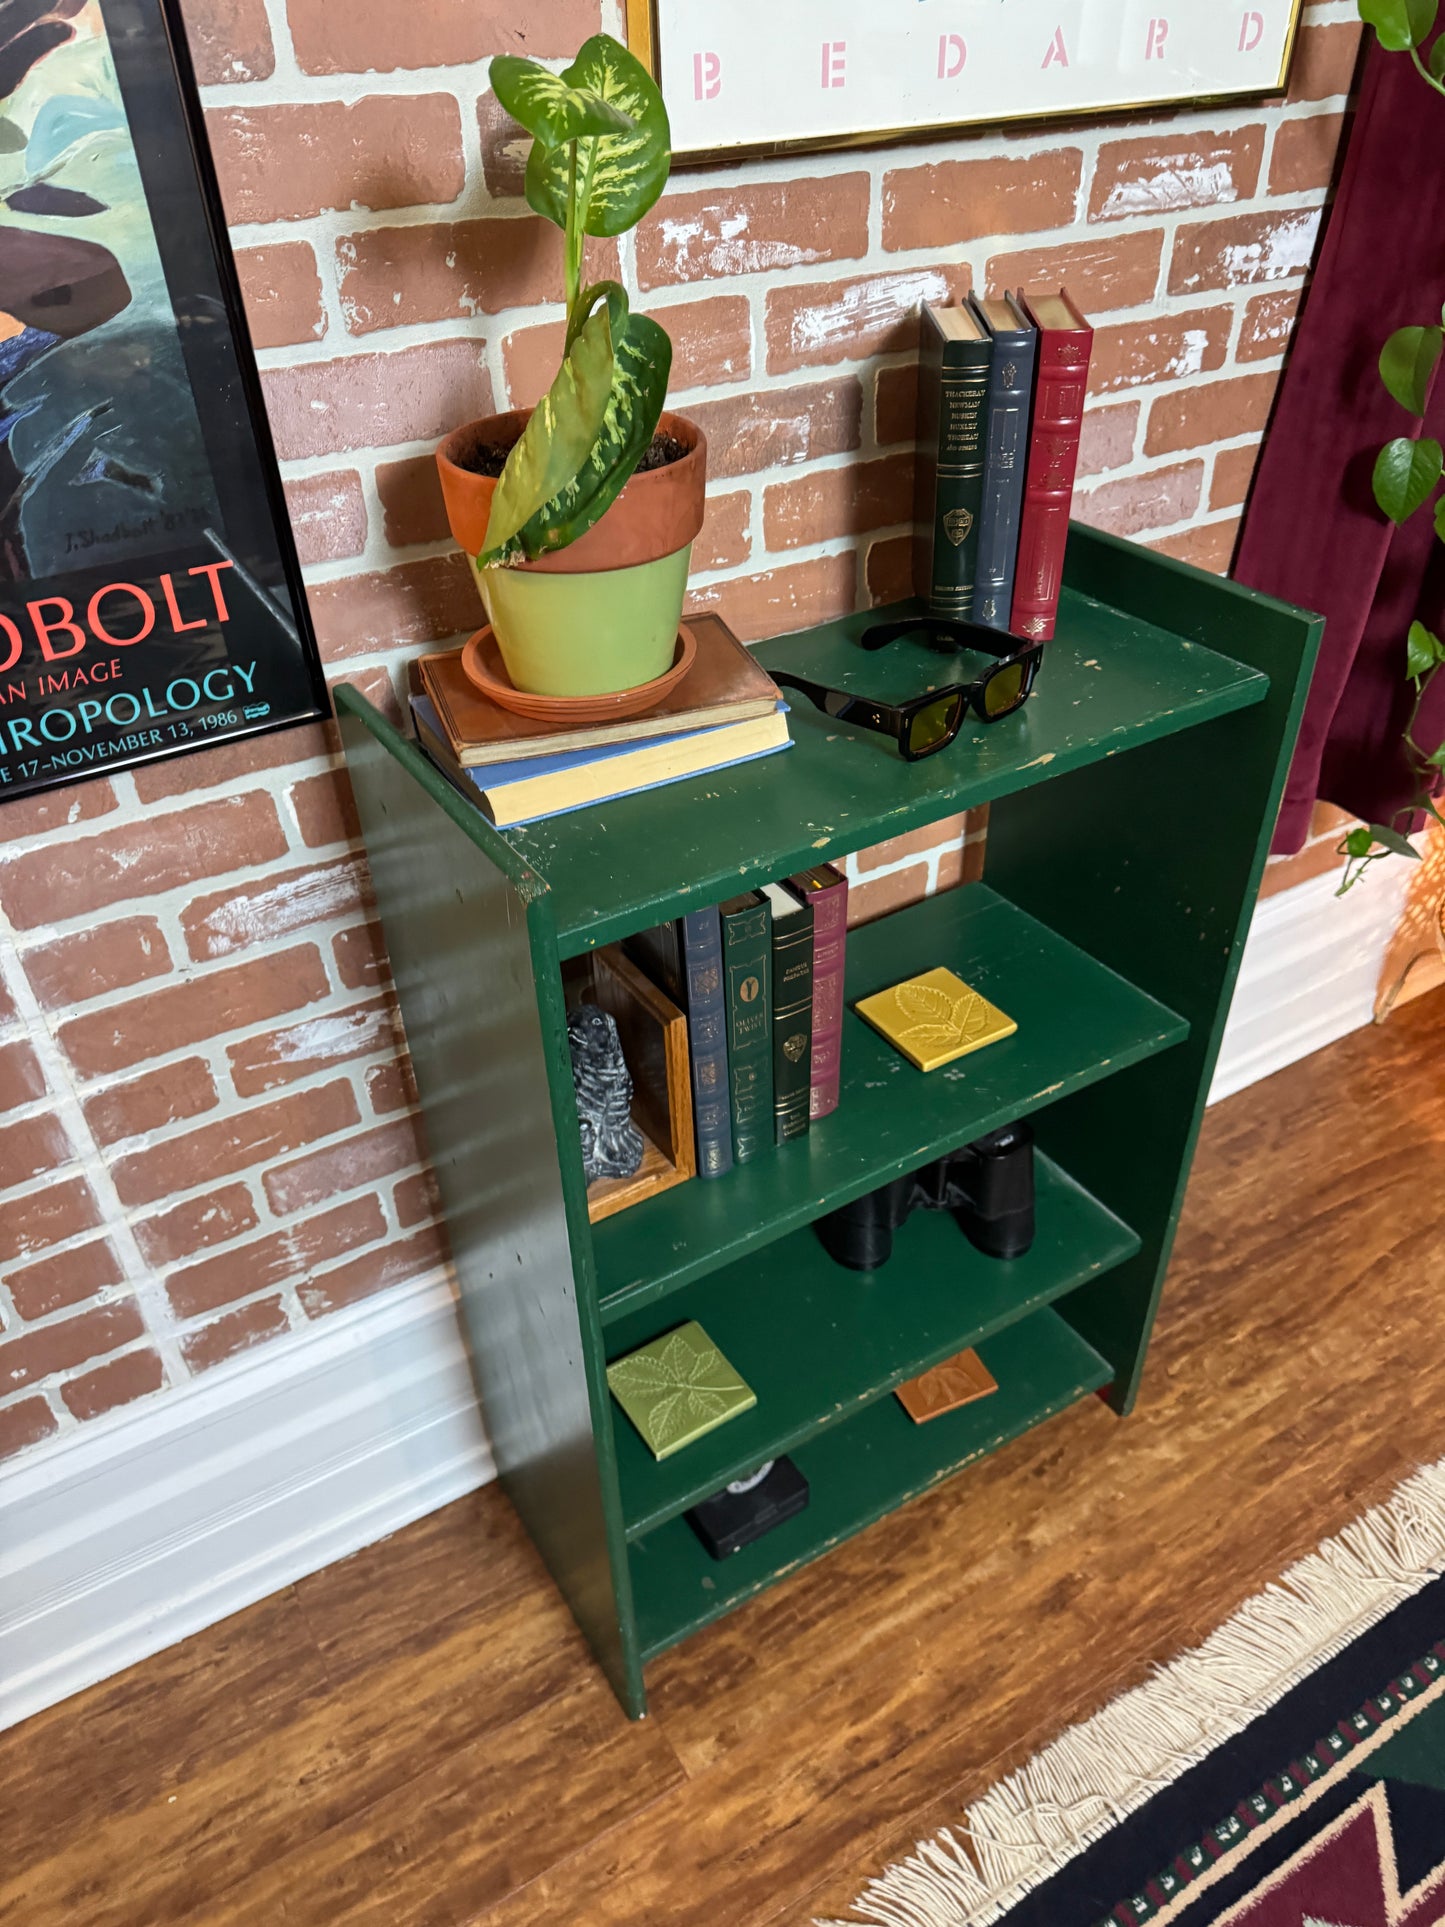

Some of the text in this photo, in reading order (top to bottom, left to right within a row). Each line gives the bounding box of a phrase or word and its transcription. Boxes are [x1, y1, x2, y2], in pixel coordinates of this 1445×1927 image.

[38, 658, 123, 696] IMAGE
[167, 721, 194, 738] 13,
[198, 709, 238, 731] 1986
